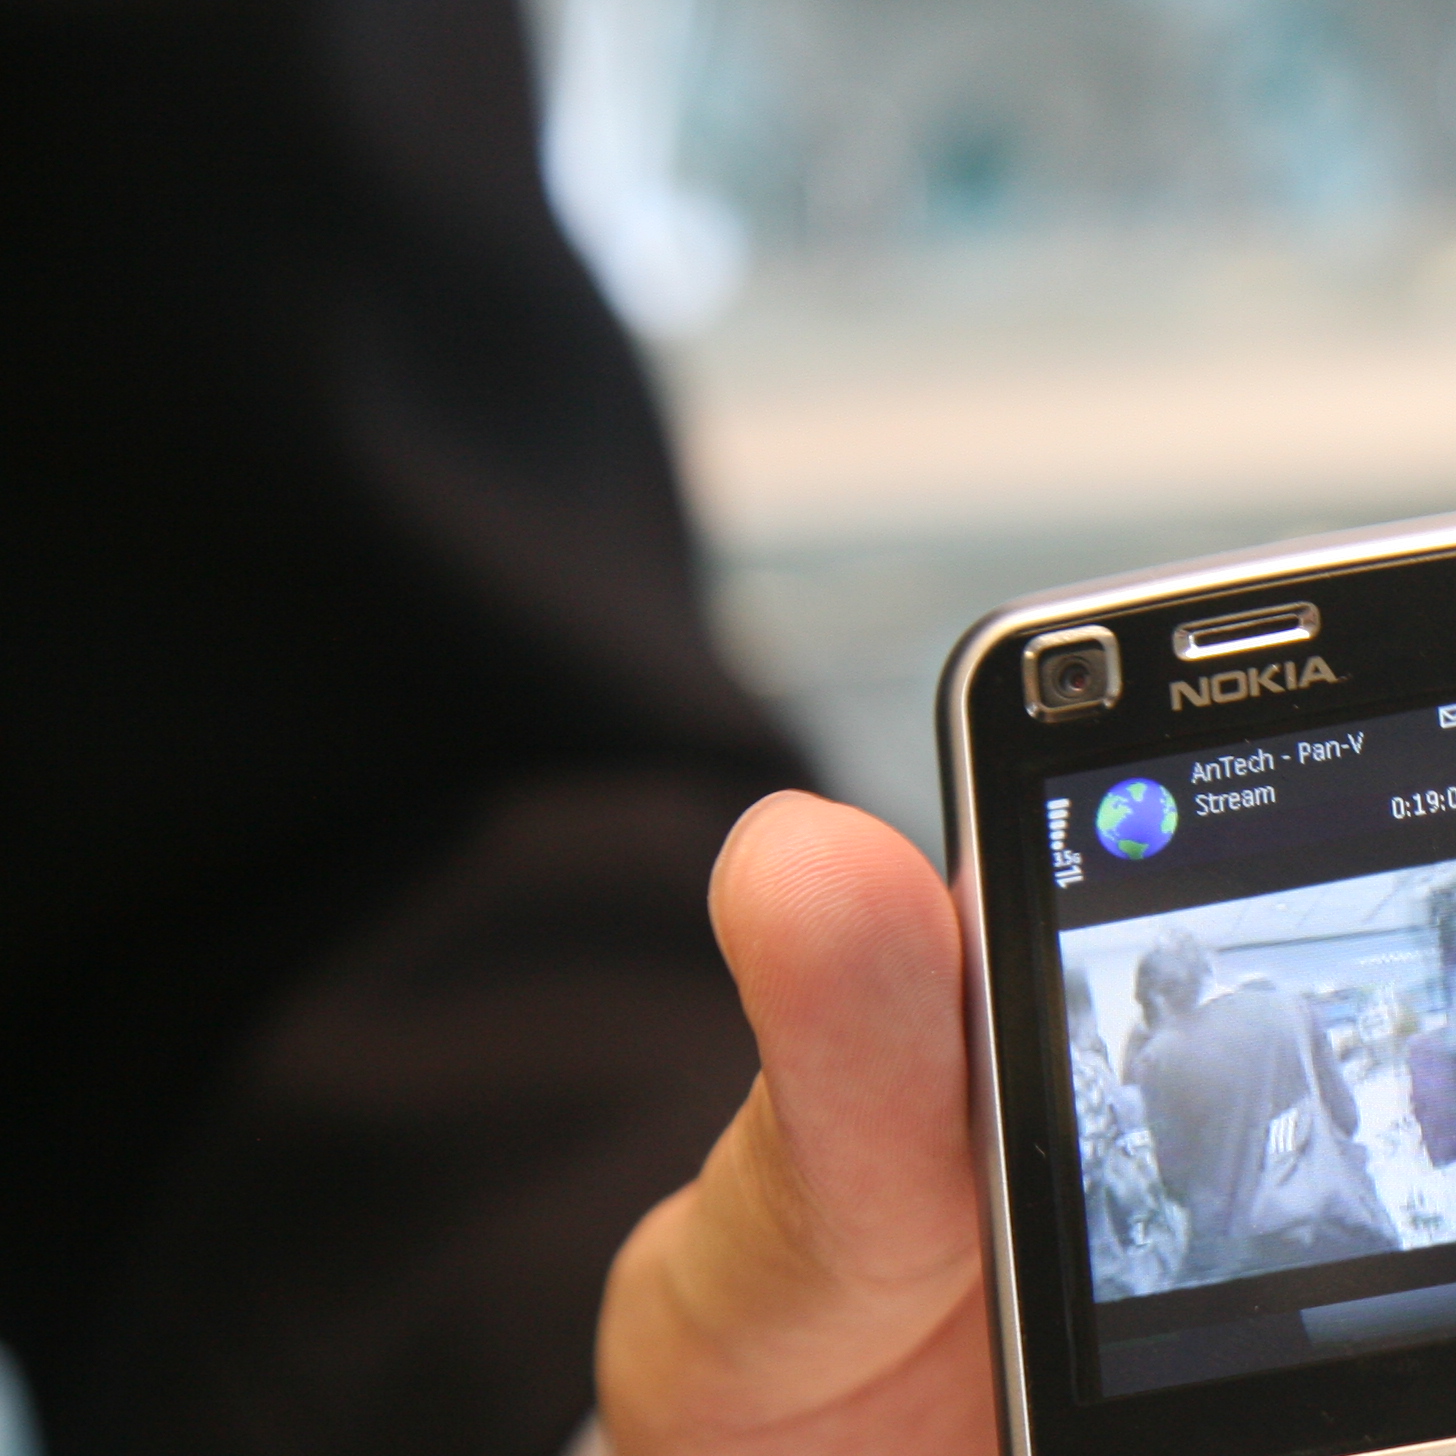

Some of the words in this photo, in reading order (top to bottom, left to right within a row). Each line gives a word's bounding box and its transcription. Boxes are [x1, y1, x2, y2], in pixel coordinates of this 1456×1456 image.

[1170, 655, 1338, 711] NOKIA
[1191, 748, 1275, 787] AnTech
[1297, 731, 1366, 766] Pan-V
[1194, 784, 1277, 818] Stream
